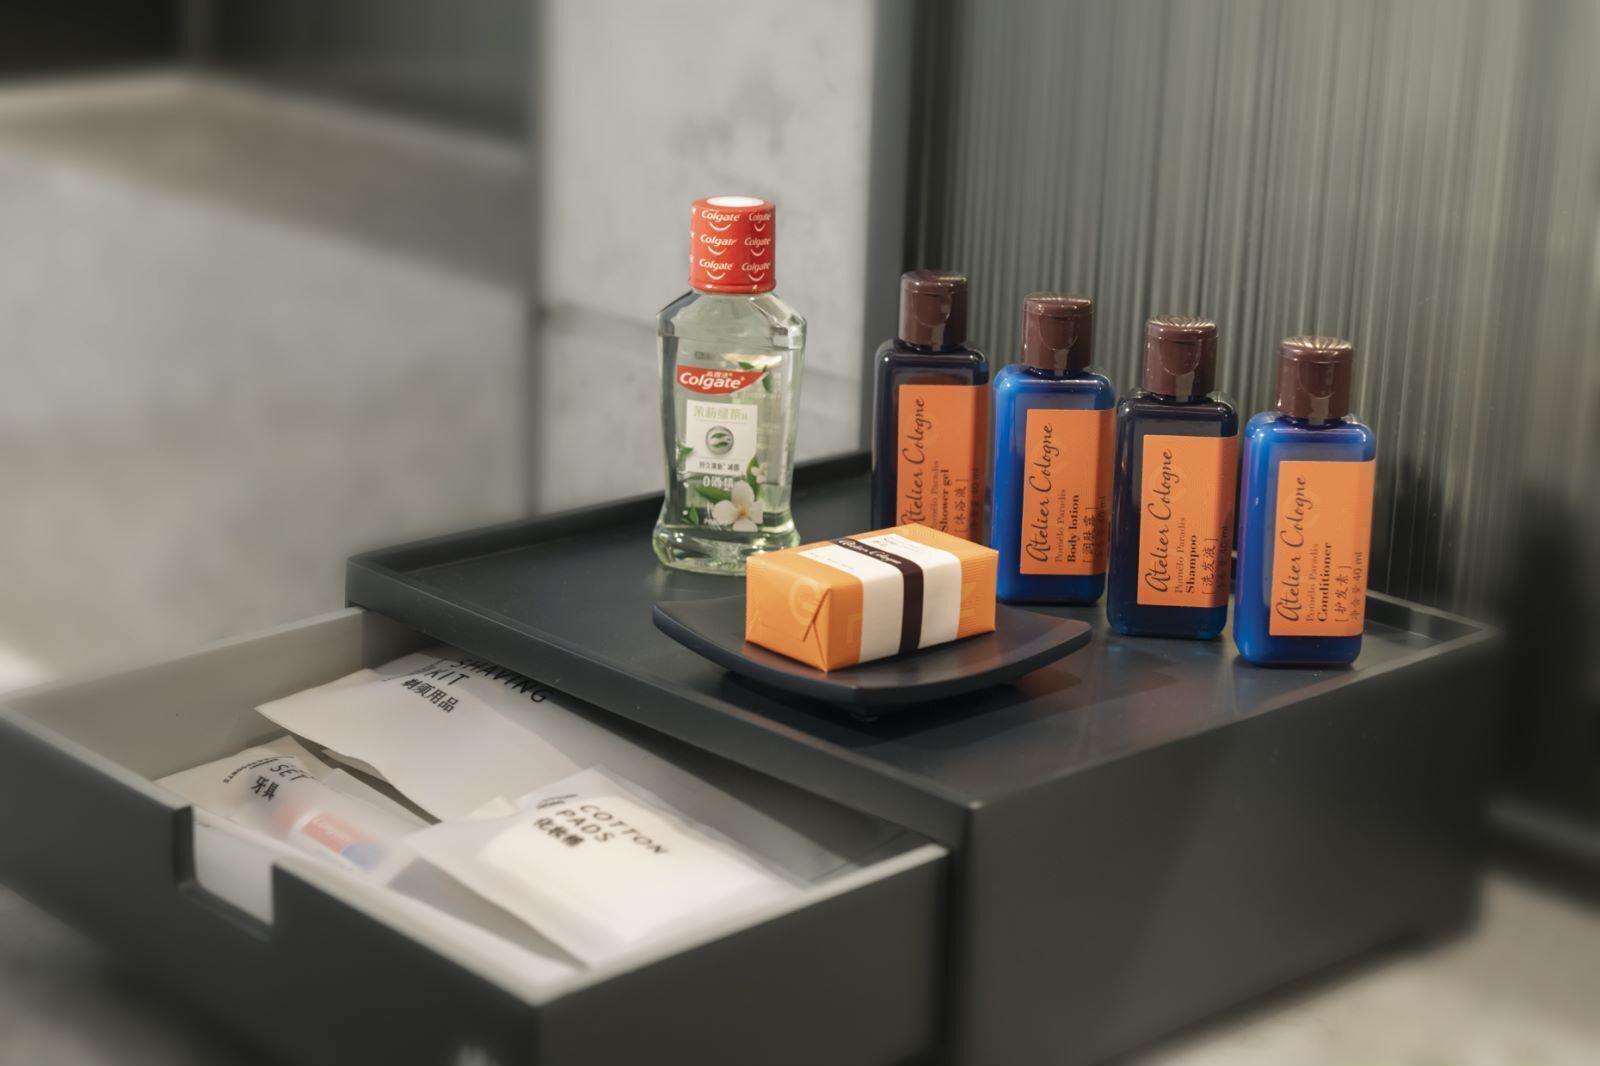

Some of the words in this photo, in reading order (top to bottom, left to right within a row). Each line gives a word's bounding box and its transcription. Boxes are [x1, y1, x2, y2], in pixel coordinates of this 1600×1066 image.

[701, 208, 740, 222] Colgate
[698, 258, 733, 271] Colgate
[680, 372, 741, 390] Colgate
[902, 396, 932, 465] Cologne
[940, 469, 952, 486] gel
[1029, 423, 1060, 492] Cologne
[1147, 449, 1180, 521] Cologne
[939, 489, 950, 533] Shower
[1025, 496, 1051, 562] Atelier
[1068, 494, 1080, 530] lotion
[1280, 475, 1313, 548] Cologne
[1067, 533, 1081, 562] Body
[1144, 526, 1171, 592] Atelier
[1185, 535, 1199, 594] Shampoo
[1275, 553, 1302, 622] Atelier
[1317, 542, 1333, 622] Conditioner
[423, 668, 470, 686] KIT
[450, 658, 551, 703] SHAVING
[250, 775, 280, 800] 牙具
[270, 763, 309, 781] SET
[555, 809, 616, 842] PADS
[579, 804, 669, 854] COTTON
